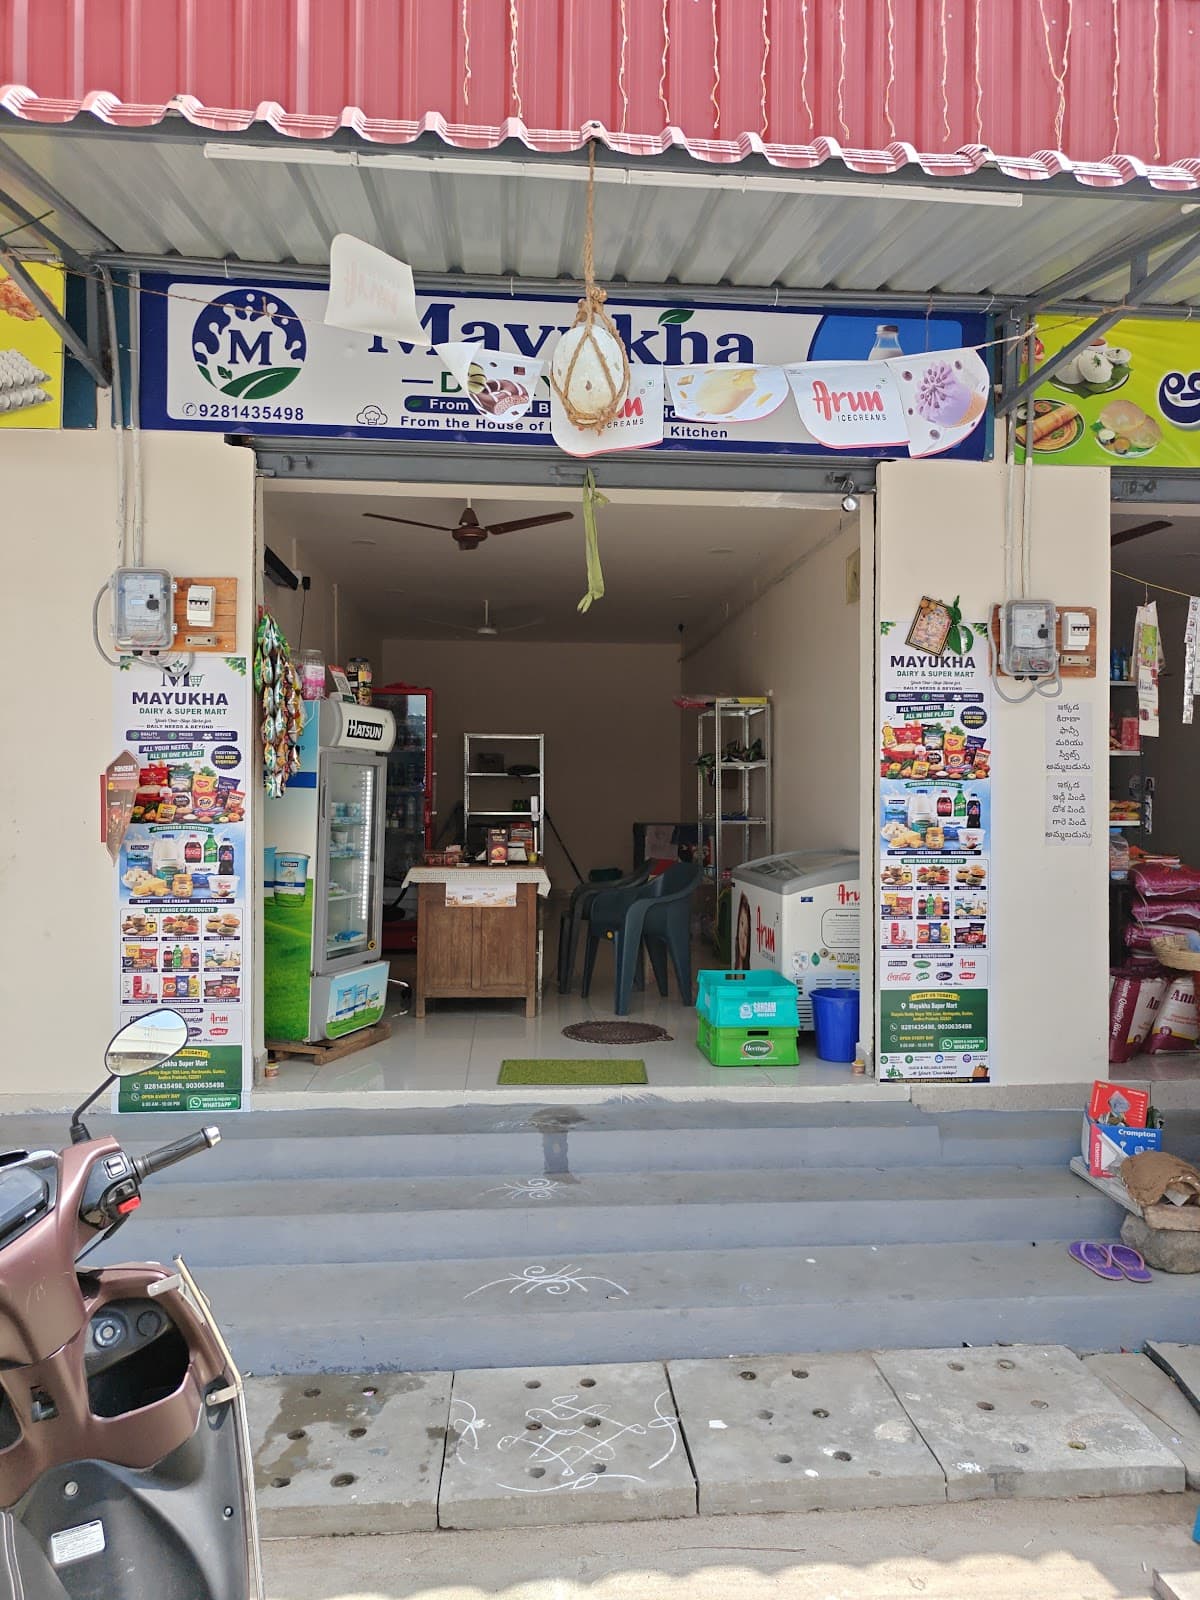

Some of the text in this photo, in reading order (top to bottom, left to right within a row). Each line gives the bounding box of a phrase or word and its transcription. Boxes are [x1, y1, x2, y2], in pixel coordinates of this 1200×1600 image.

[227, 329, 274, 366] M
[429, 399, 470, 411] From
[812, 380, 885, 421] Arun
[198, 404, 305, 422] 9281435498
[837, 414, 887, 424] ICECREAMS
[400, 416, 545, 431] From the House of
[670, 426, 728, 438] Kitchen
[890, 654, 976, 669] MAYUKHA
[928, 670, 952, 678] SUPER
[132, 691, 229, 706] MAYUKHA
[174, 708, 202, 716] SUPER
[204, 708, 228, 716] MART
[348, 719, 384, 740] HATSUN
[1118, 1128, 1157, 1139] Crompton
